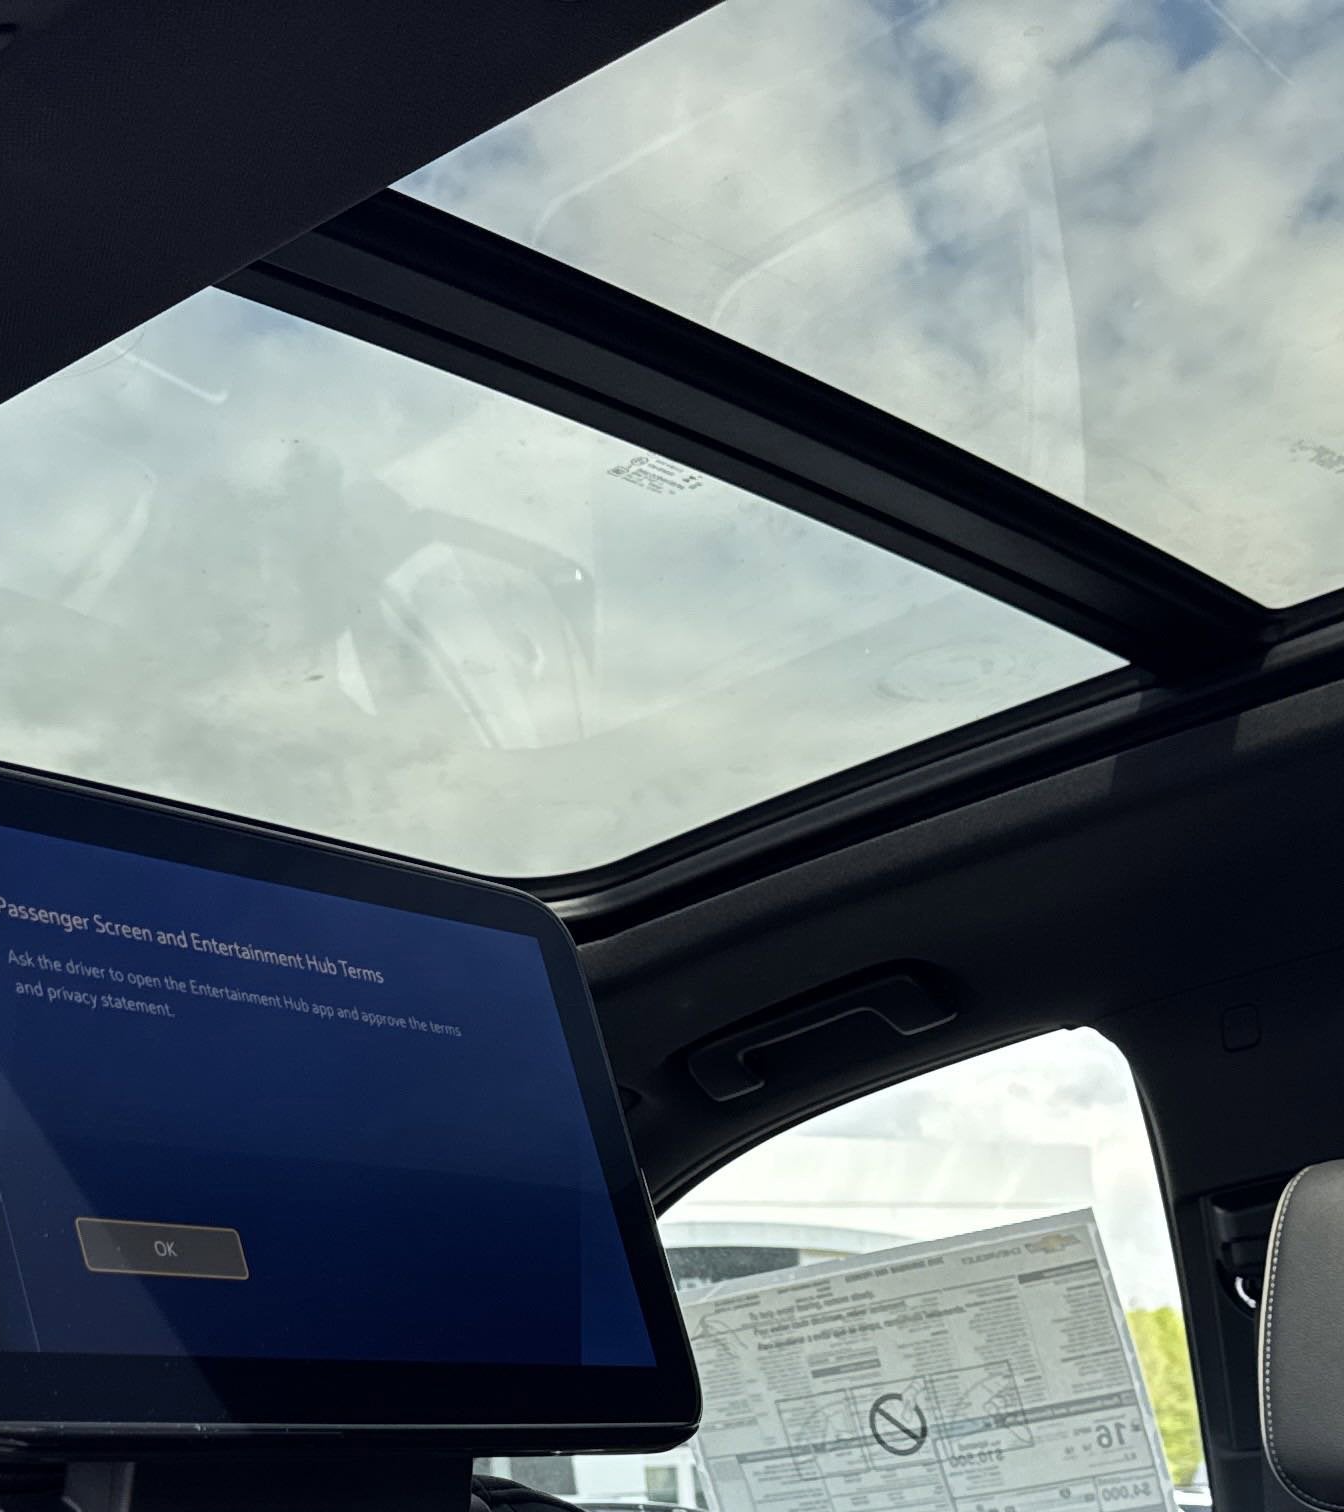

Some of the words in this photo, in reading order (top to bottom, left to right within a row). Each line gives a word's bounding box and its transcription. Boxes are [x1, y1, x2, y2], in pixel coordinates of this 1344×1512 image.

[93, 913, 153, 942] Screen
[156, 930, 188, 949] and
[190, 932, 305, 970] Entertainment
[305, 954, 337, 976] Hub
[337, 959, 384, 984] Terms
[8, 949, 35, 968] Ask
[37, 955, 62, 972] the
[66, 960, 105, 980] driver
[108, 968, 124, 982] to
[127, 971, 161, 989] open
[164, 975, 187, 993] the
[190, 979, 282, 1009] Entertainment
[282, 994, 310, 1013] Hub
[312, 1003, 334, 1020] app
[337, 1005, 359, 1021] and
[361, 1011, 407, 1029] approve
[408, 1016, 428, 1032] the
[429, 1020, 462, 1037] terms
[15, 980, 43, 997] and
[47, 986, 98, 1009] privacy
[101, 994, 175, 1018] statement.
[154, 1240, 178, 1257] OK
